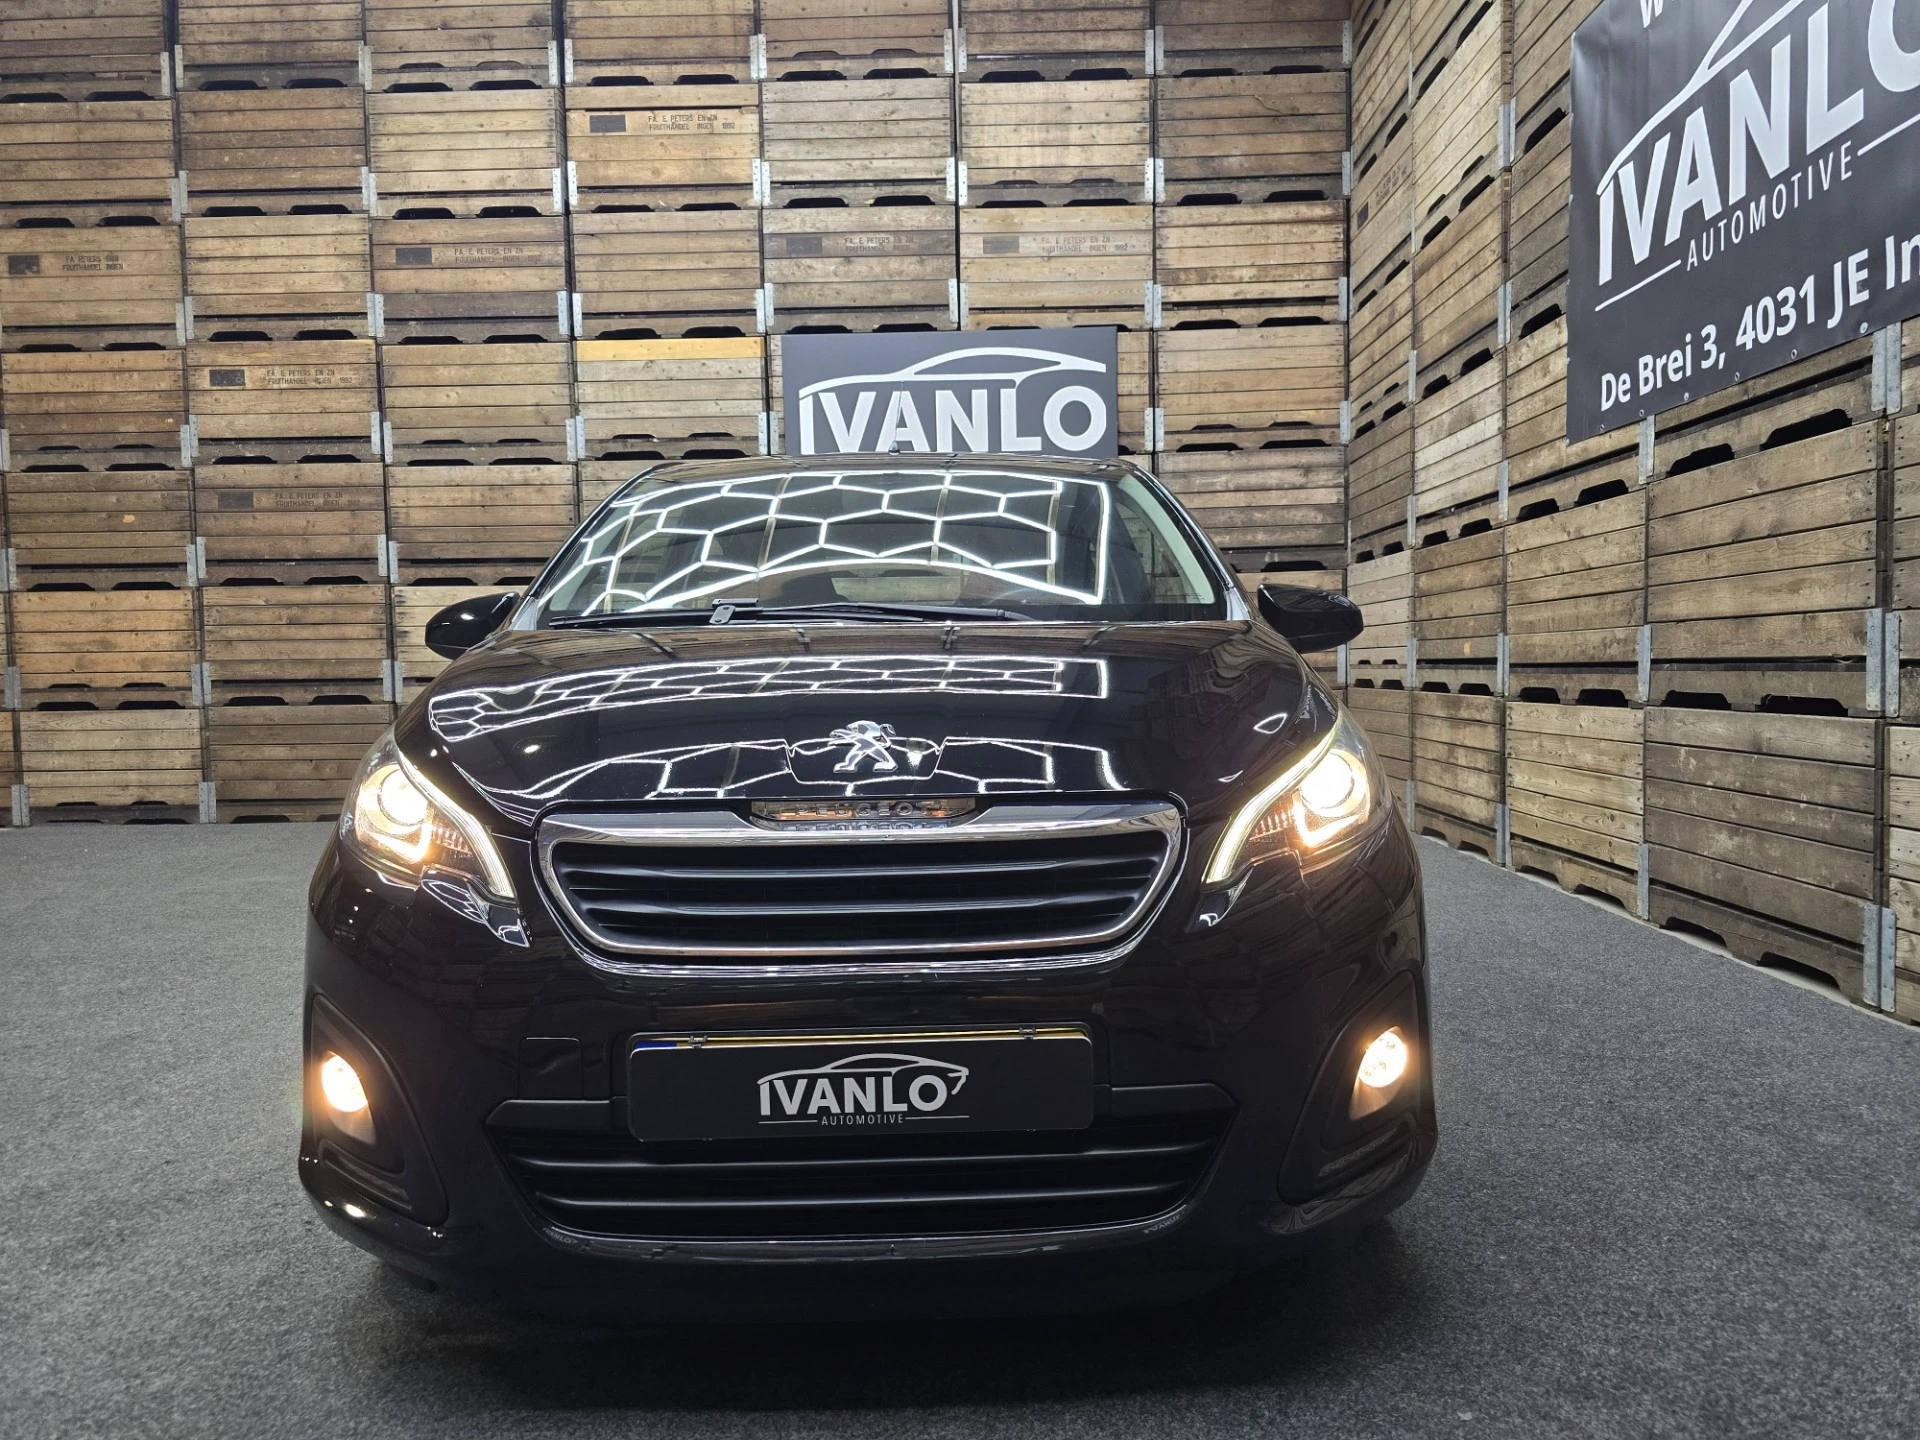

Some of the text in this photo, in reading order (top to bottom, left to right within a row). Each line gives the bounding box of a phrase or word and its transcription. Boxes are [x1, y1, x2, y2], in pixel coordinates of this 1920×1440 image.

[670, 114, 694, 122] PETERS
[649, 123, 690, 131] FRUITHANDEL
[1687, 140, 1852, 272] AUTOMOTIVE
[866, 236, 890, 244] PETERS
[1063, 236, 1087, 244] PETERS
[78, 255, 102, 263] PETERS
[1601, 373, 1631, 412] De
[1638, 333, 1692, 397] Brei
[1701, 324, 1727, 370] 3,
[1735, 275, 1816, 351] 4031
[1827, 249, 1870, 329] JE
[799, 385, 1107, 455] IVANLO
[760, 1075, 948, 1116] IVANLO
[821, 1114, 904, 1126] AUTOMOTIVE
